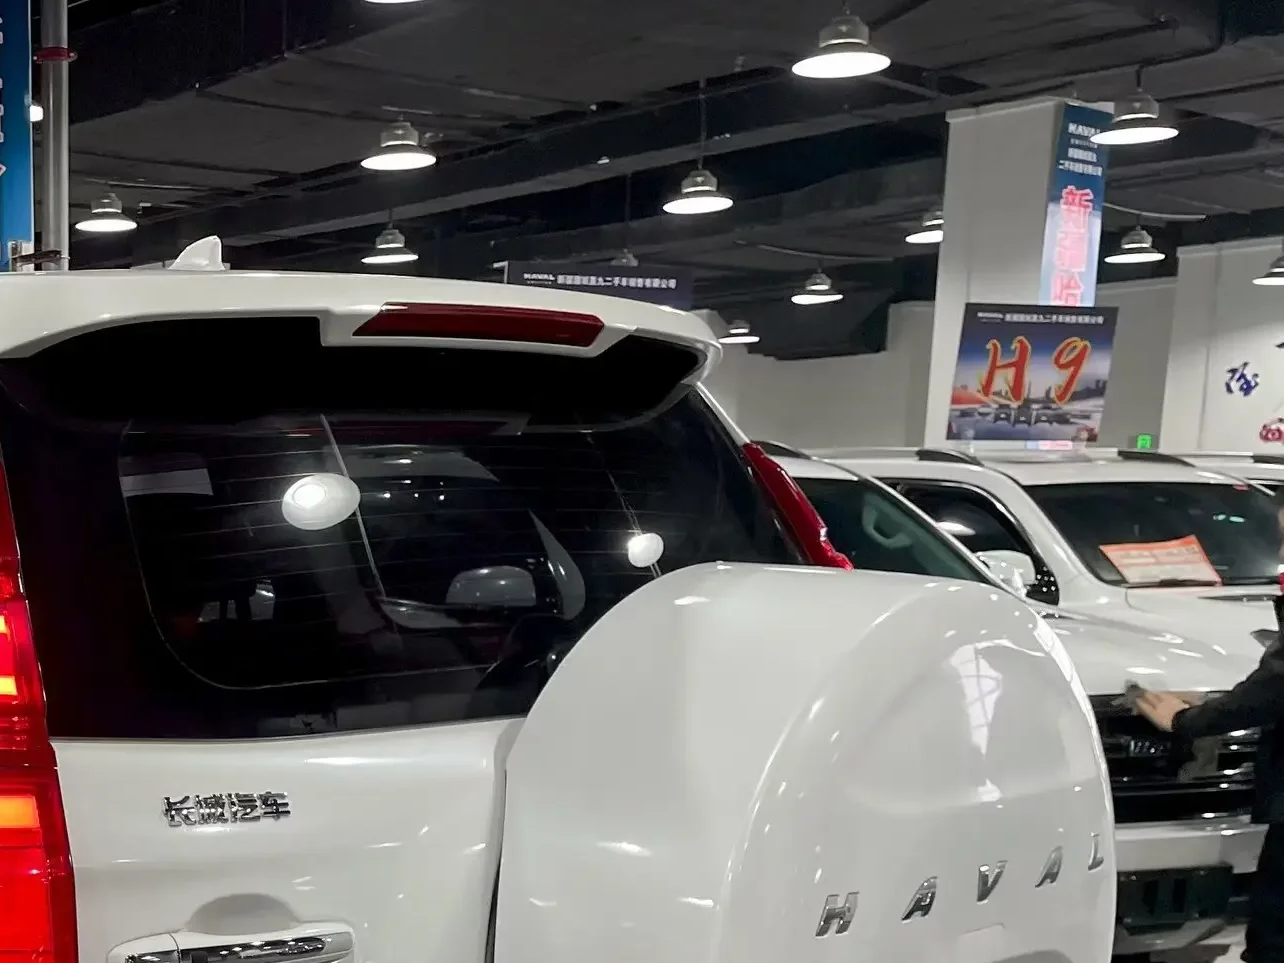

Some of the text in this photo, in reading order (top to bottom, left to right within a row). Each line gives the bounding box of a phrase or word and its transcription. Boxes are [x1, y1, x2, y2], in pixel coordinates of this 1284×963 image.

[163, 791, 291, 827] 长城汽车
[814, 832, 1105, 938] HAVAL
